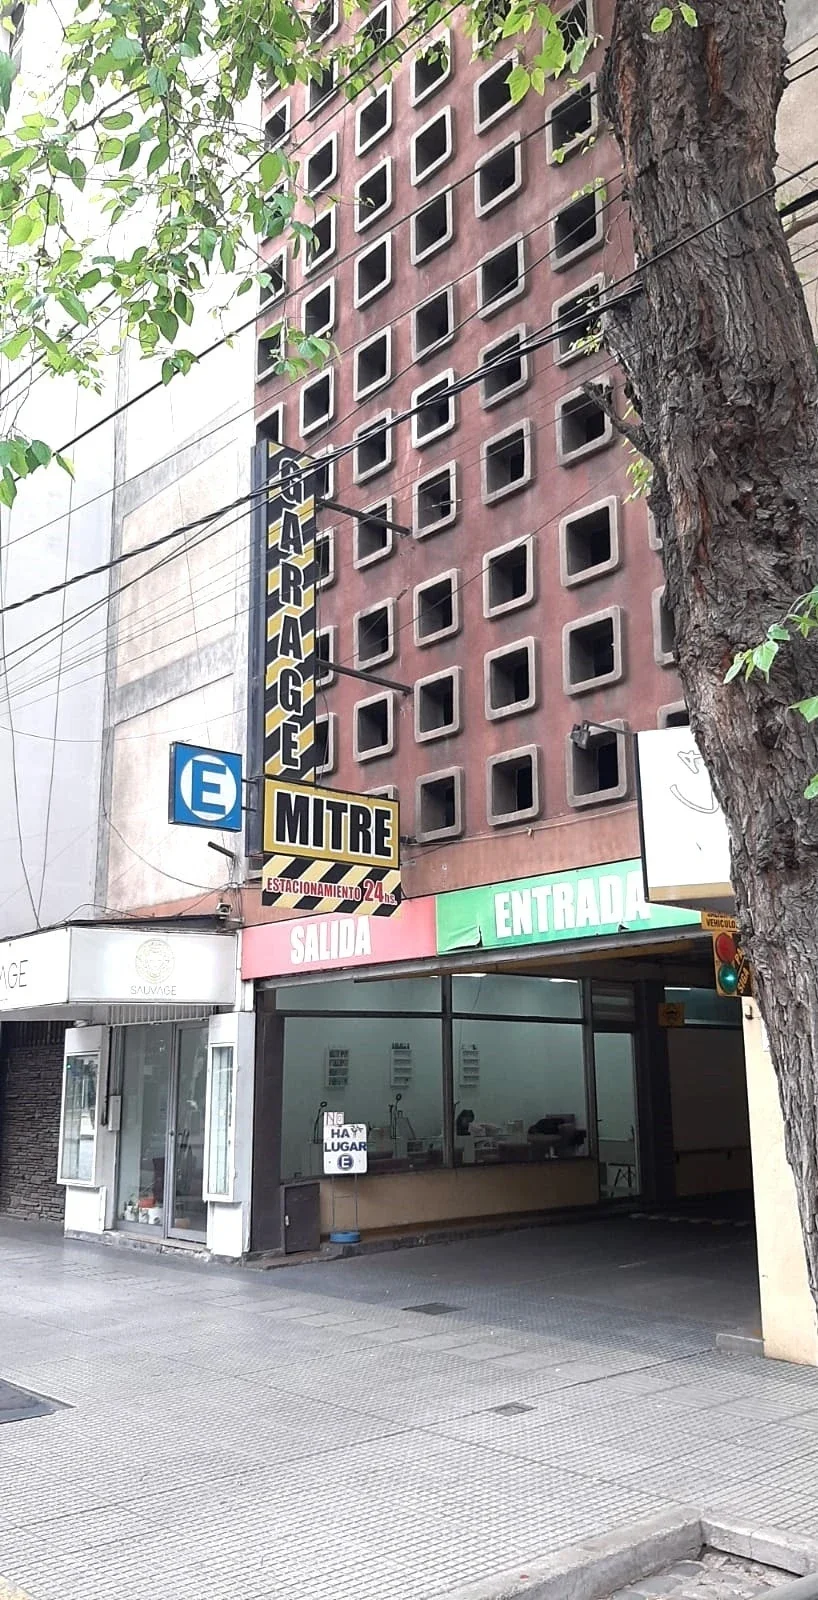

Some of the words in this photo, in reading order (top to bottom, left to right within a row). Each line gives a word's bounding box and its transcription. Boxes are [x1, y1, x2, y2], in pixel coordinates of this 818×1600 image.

[278, 457, 304, 770] GARAGE
[192, 759, 226, 815] E
[275, 790, 393, 858] MITRE
[266, 877, 361, 901] ESTACIONAMIENTO
[494, 870, 651, 939] ENTRADA
[290, 915, 371, 965] SALIDA
[706, 918, 737, 929] VEHICULO
[130, 985, 177, 996] SAUVAGE
[324, 1141, 367, 1152] LUGAR
